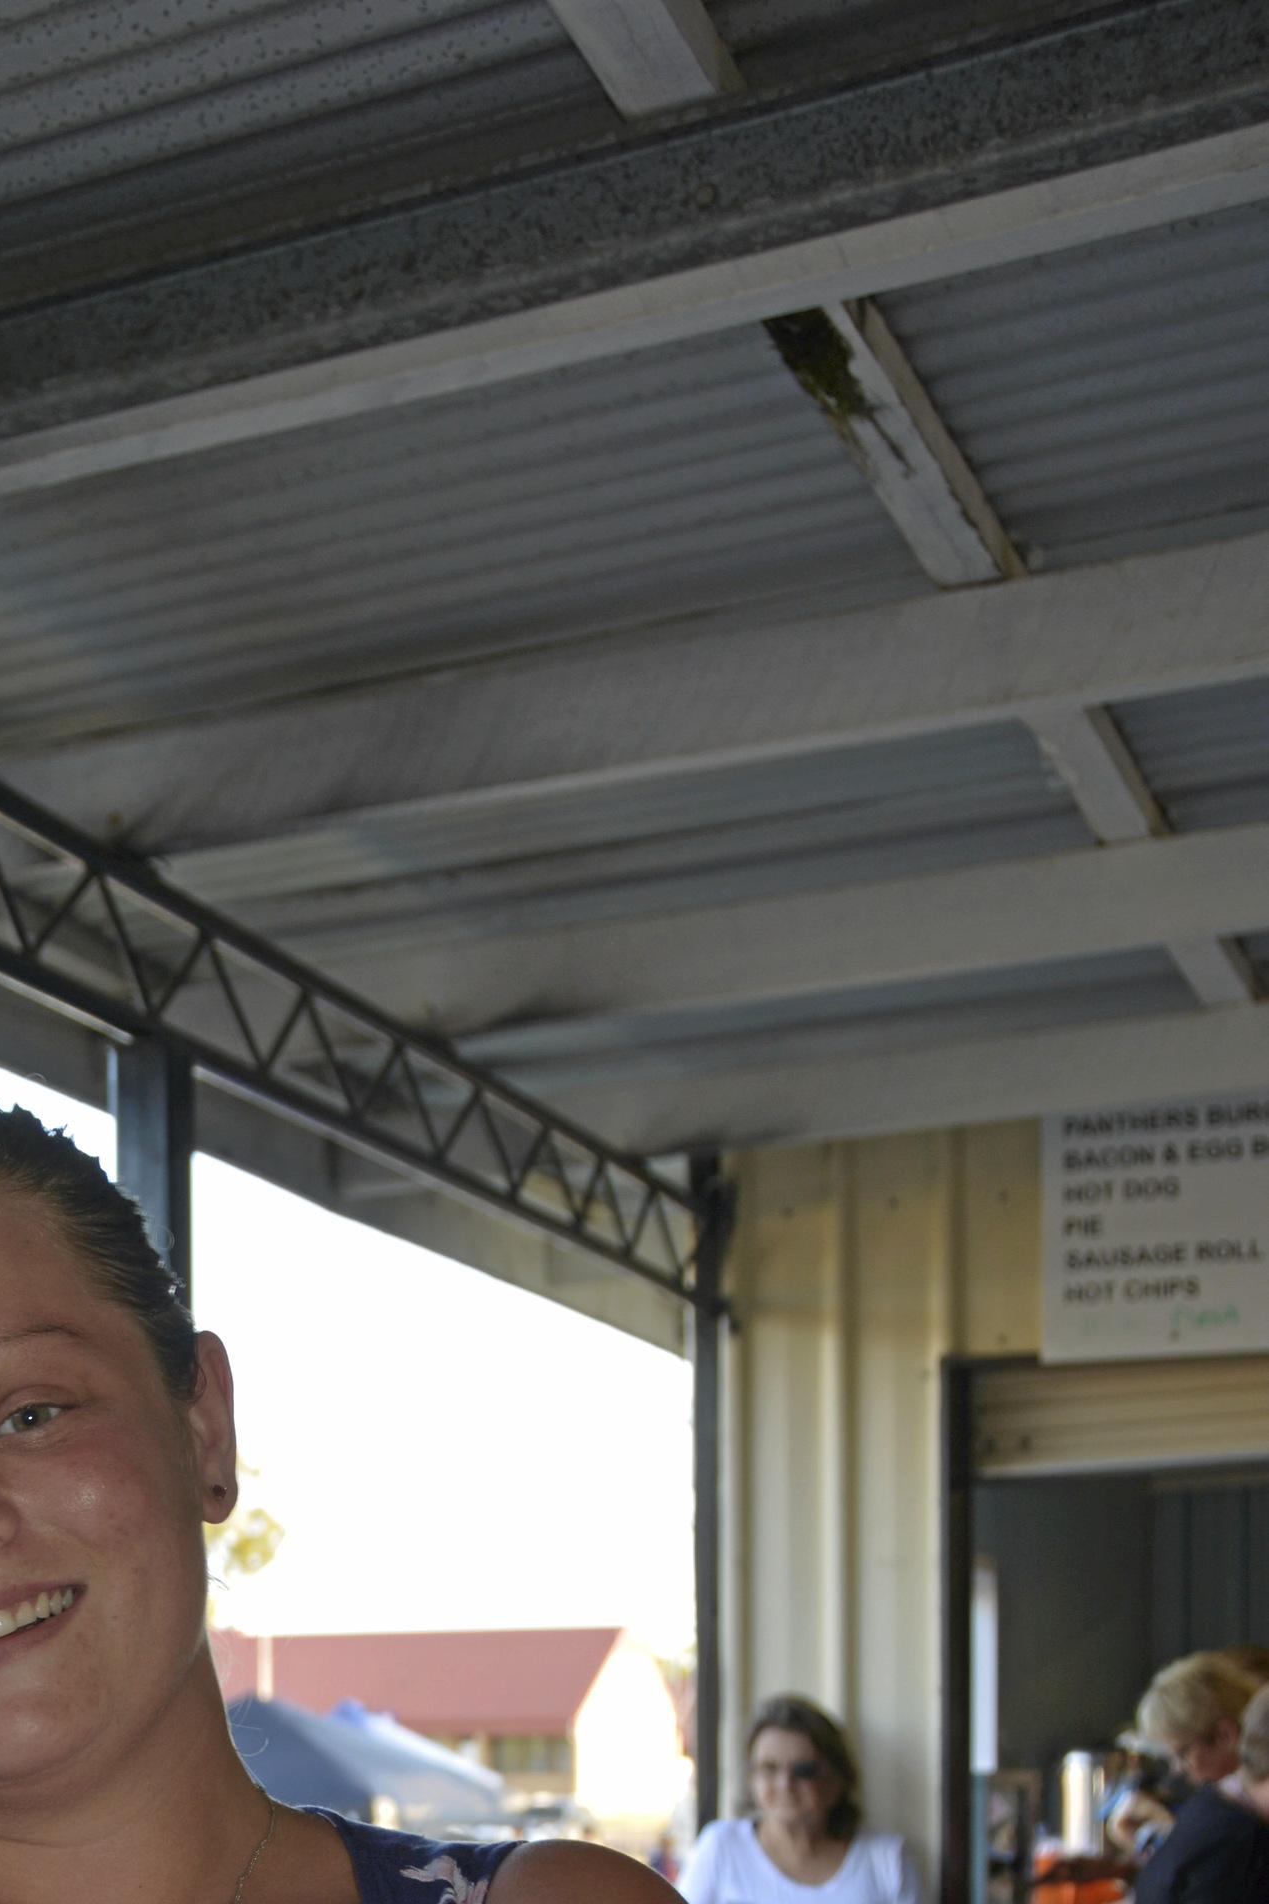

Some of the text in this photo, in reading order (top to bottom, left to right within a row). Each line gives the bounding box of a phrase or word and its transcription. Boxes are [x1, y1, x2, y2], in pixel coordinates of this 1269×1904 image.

[1066, 1147, 1153, 1170] BACON
[1190, 1140, 1243, 1162] EGG
[1065, 1178, 1179, 1202] HOT DOG
[1065, 1217, 1100, 1237] PIE
[1067, 1240, 1260, 1268] SAUSAGE ROLL
[1065, 1277, 1199, 1304] HOT CHIPS
